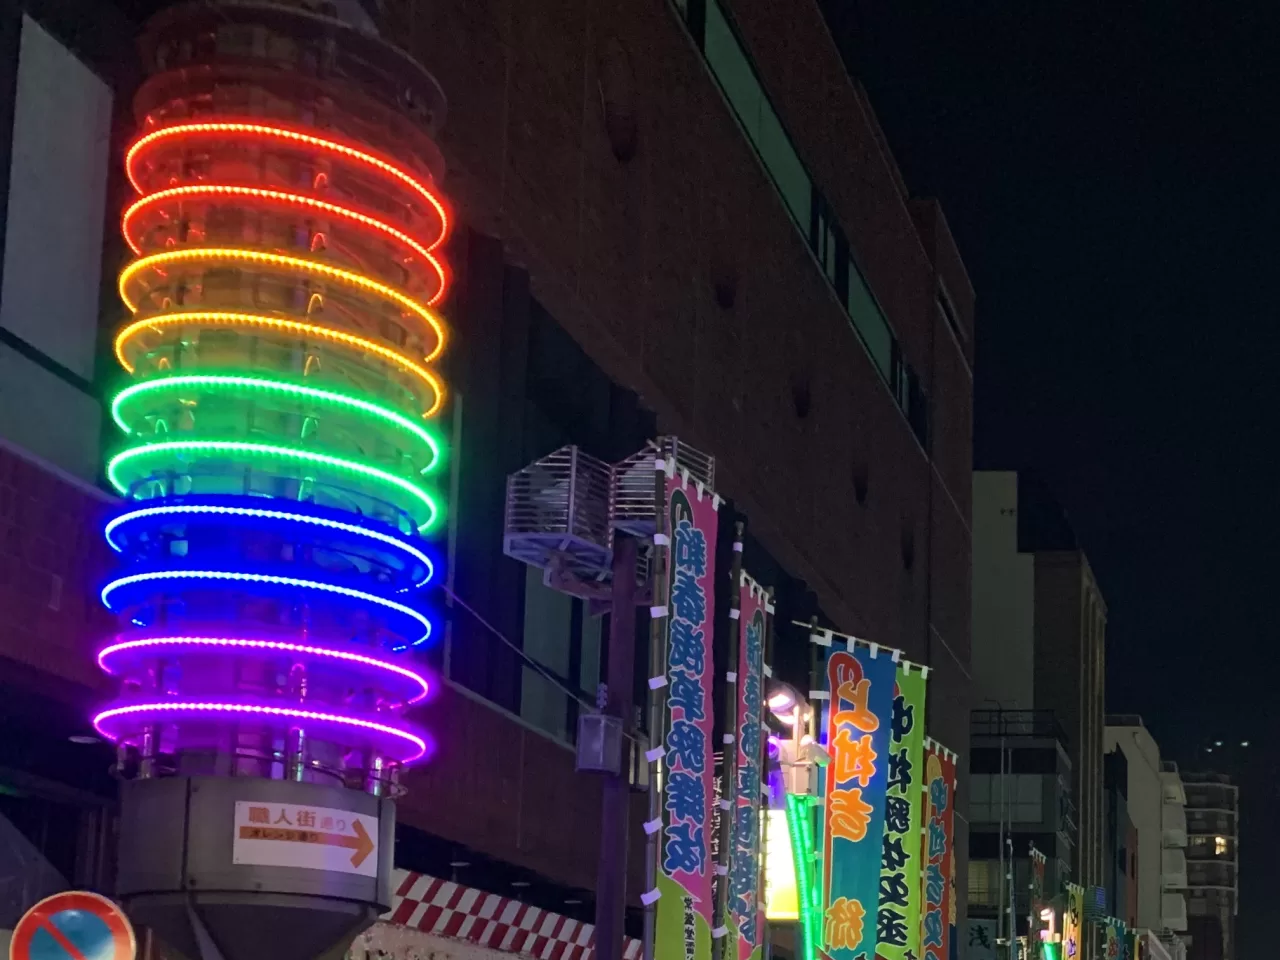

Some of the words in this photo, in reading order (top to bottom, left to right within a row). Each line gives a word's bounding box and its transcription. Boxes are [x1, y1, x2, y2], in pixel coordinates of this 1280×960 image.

[248, 806, 347, 831] 職人街通り
[248, 829, 319, 843] オレンジ通り
